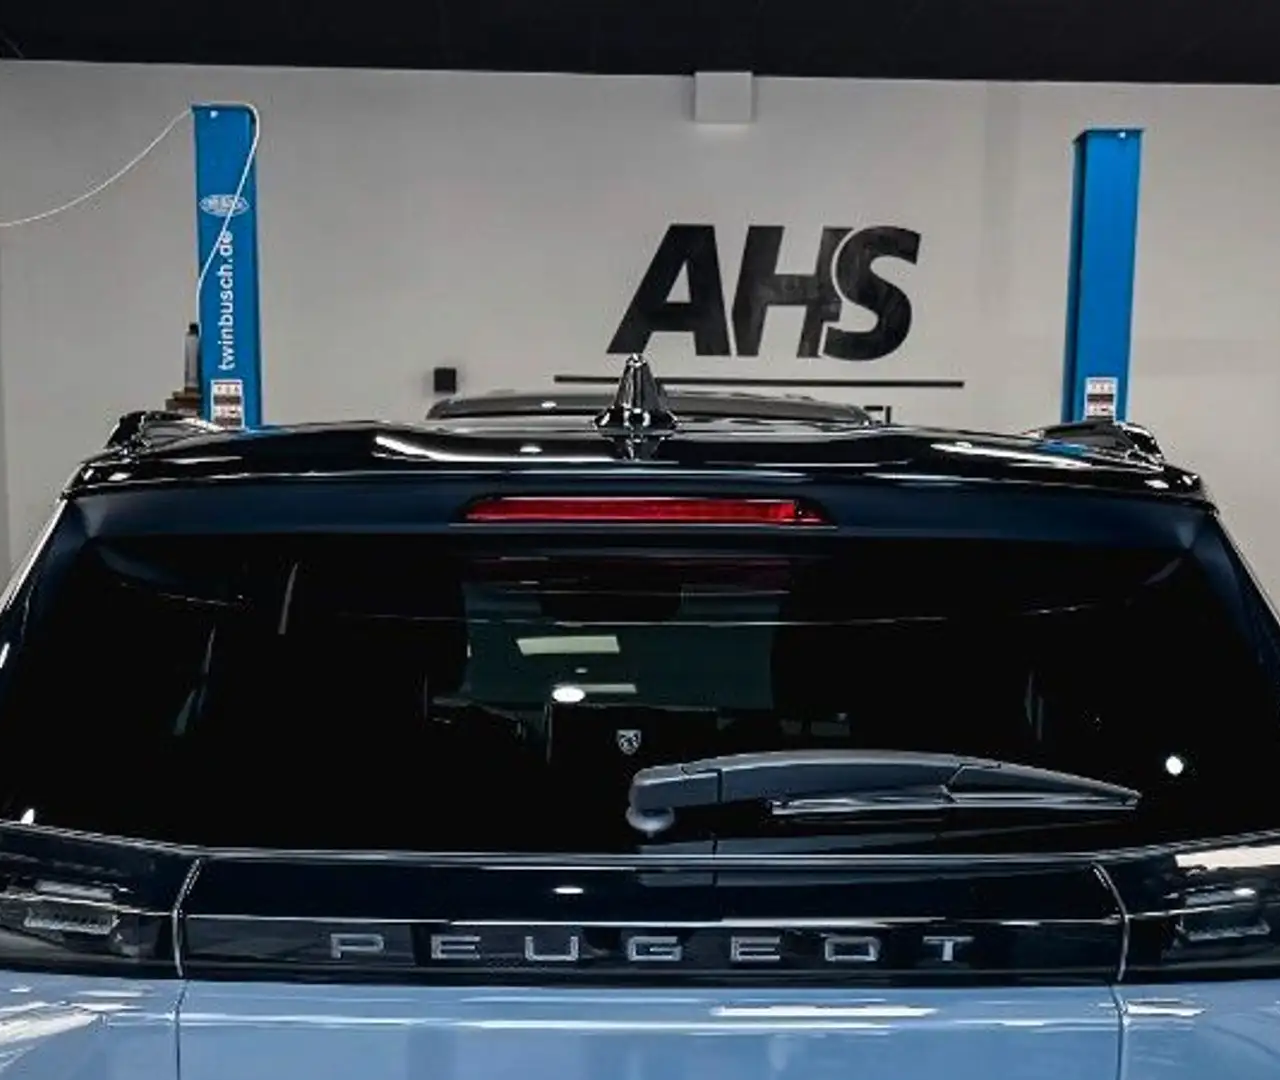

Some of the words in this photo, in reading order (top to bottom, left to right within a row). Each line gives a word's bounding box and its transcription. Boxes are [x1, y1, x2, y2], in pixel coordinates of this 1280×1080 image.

[217, 230, 235, 372] twinbusch.de
[606, 223, 922, 362] AHS
[330, 933, 974, 962] PEUGEOT
